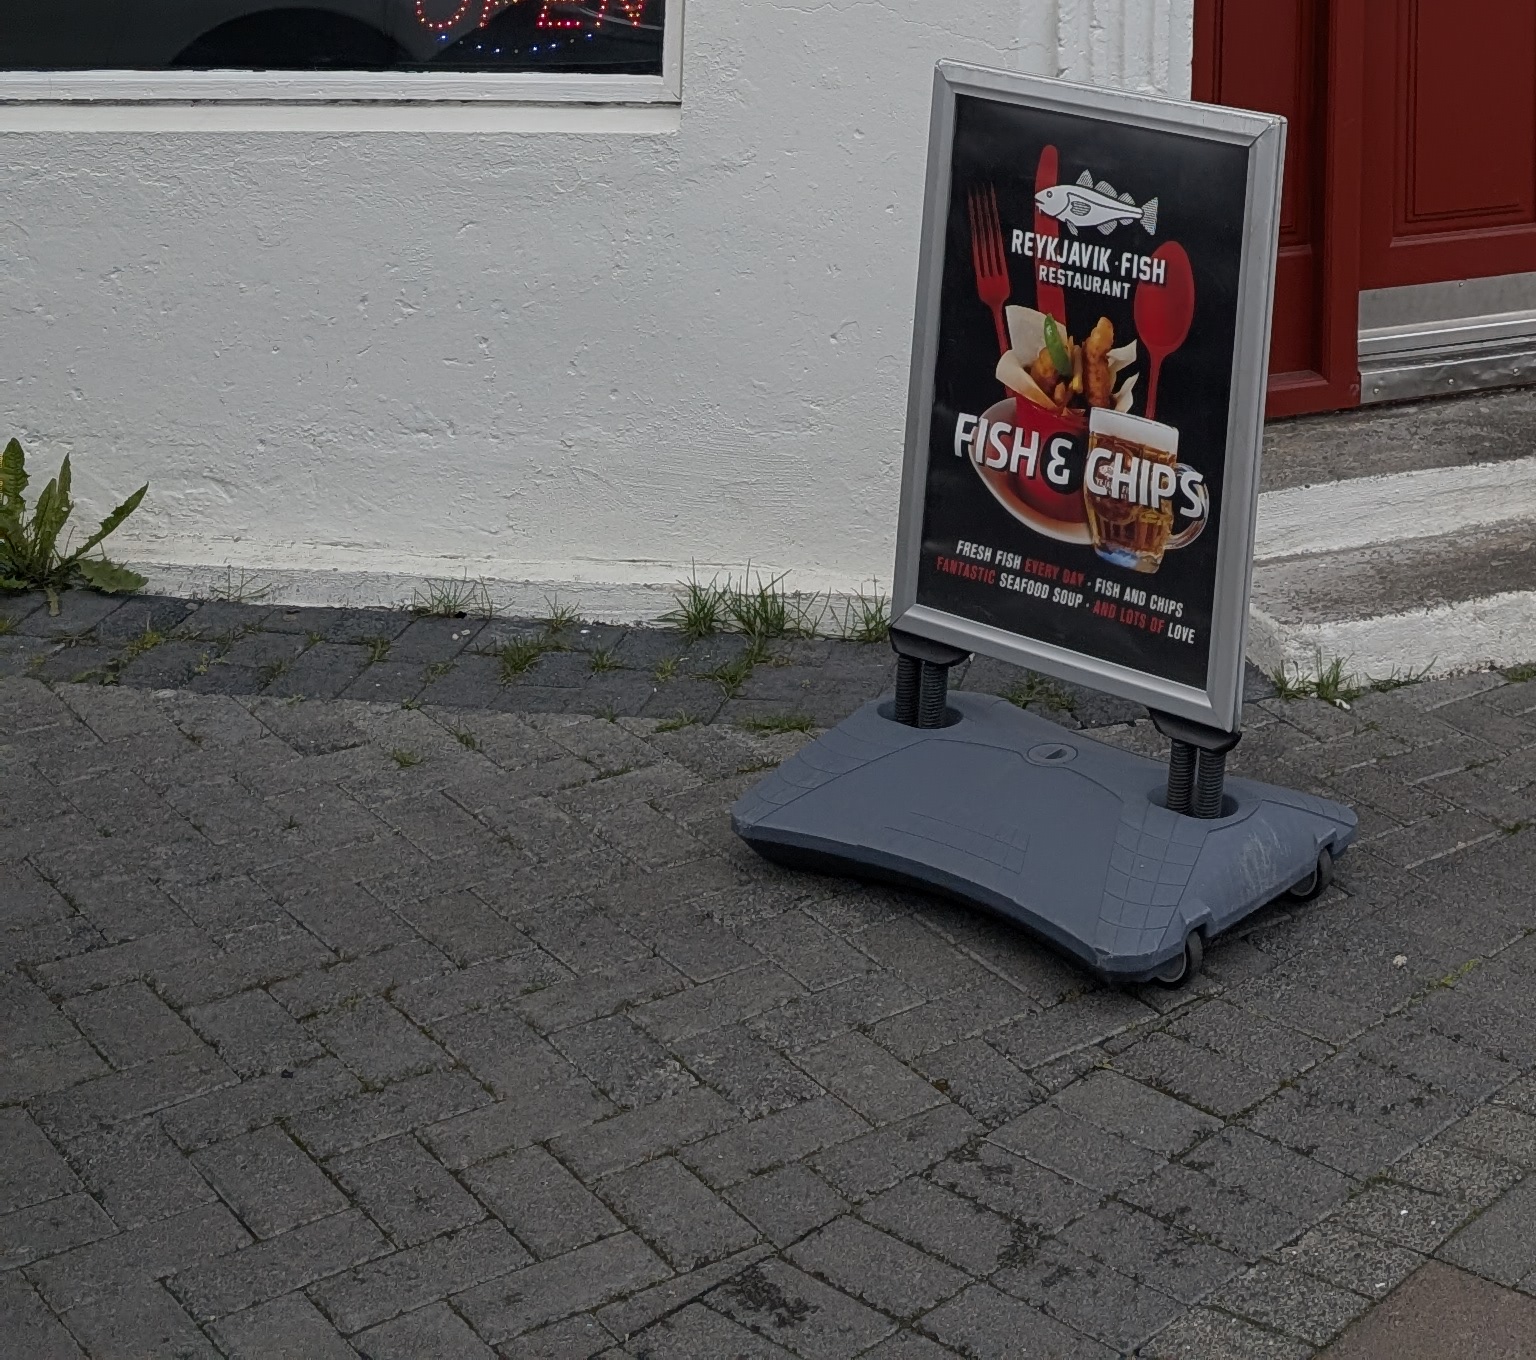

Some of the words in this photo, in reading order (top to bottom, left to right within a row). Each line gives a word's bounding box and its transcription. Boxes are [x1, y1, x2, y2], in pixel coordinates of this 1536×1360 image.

[1011, 229, 1112, 273] REYKJAVIK
[1121, 252, 1165, 284] FISH
[1039, 265, 1131, 299] RESTAURANT
[953, 412, 1040, 477] FISH
[1086, 447, 1206, 518] CHIPS
[936, 556, 995, 584] FANTASTIC
[999, 573, 1049, 599] SEAFOOD
[1052, 587, 1083, 608] SOUP
[1093, 600, 1115, 619] AND
[1120, 607, 1146, 629] LOTS
[1150, 617, 1165, 632] OF
[1168, 623, 1195, 644] LOVE
[956, 540, 991, 562] FRESH
[995, 550, 1022, 570] FISH
[1024, 558, 1060, 580] EVERY
[1062, 569, 1085, 585] DAY
[1095, 579, 1120, 599] FISH
[1123, 587, 1146, 606] AND
[1150, 595, 1184, 617] CHIPS
